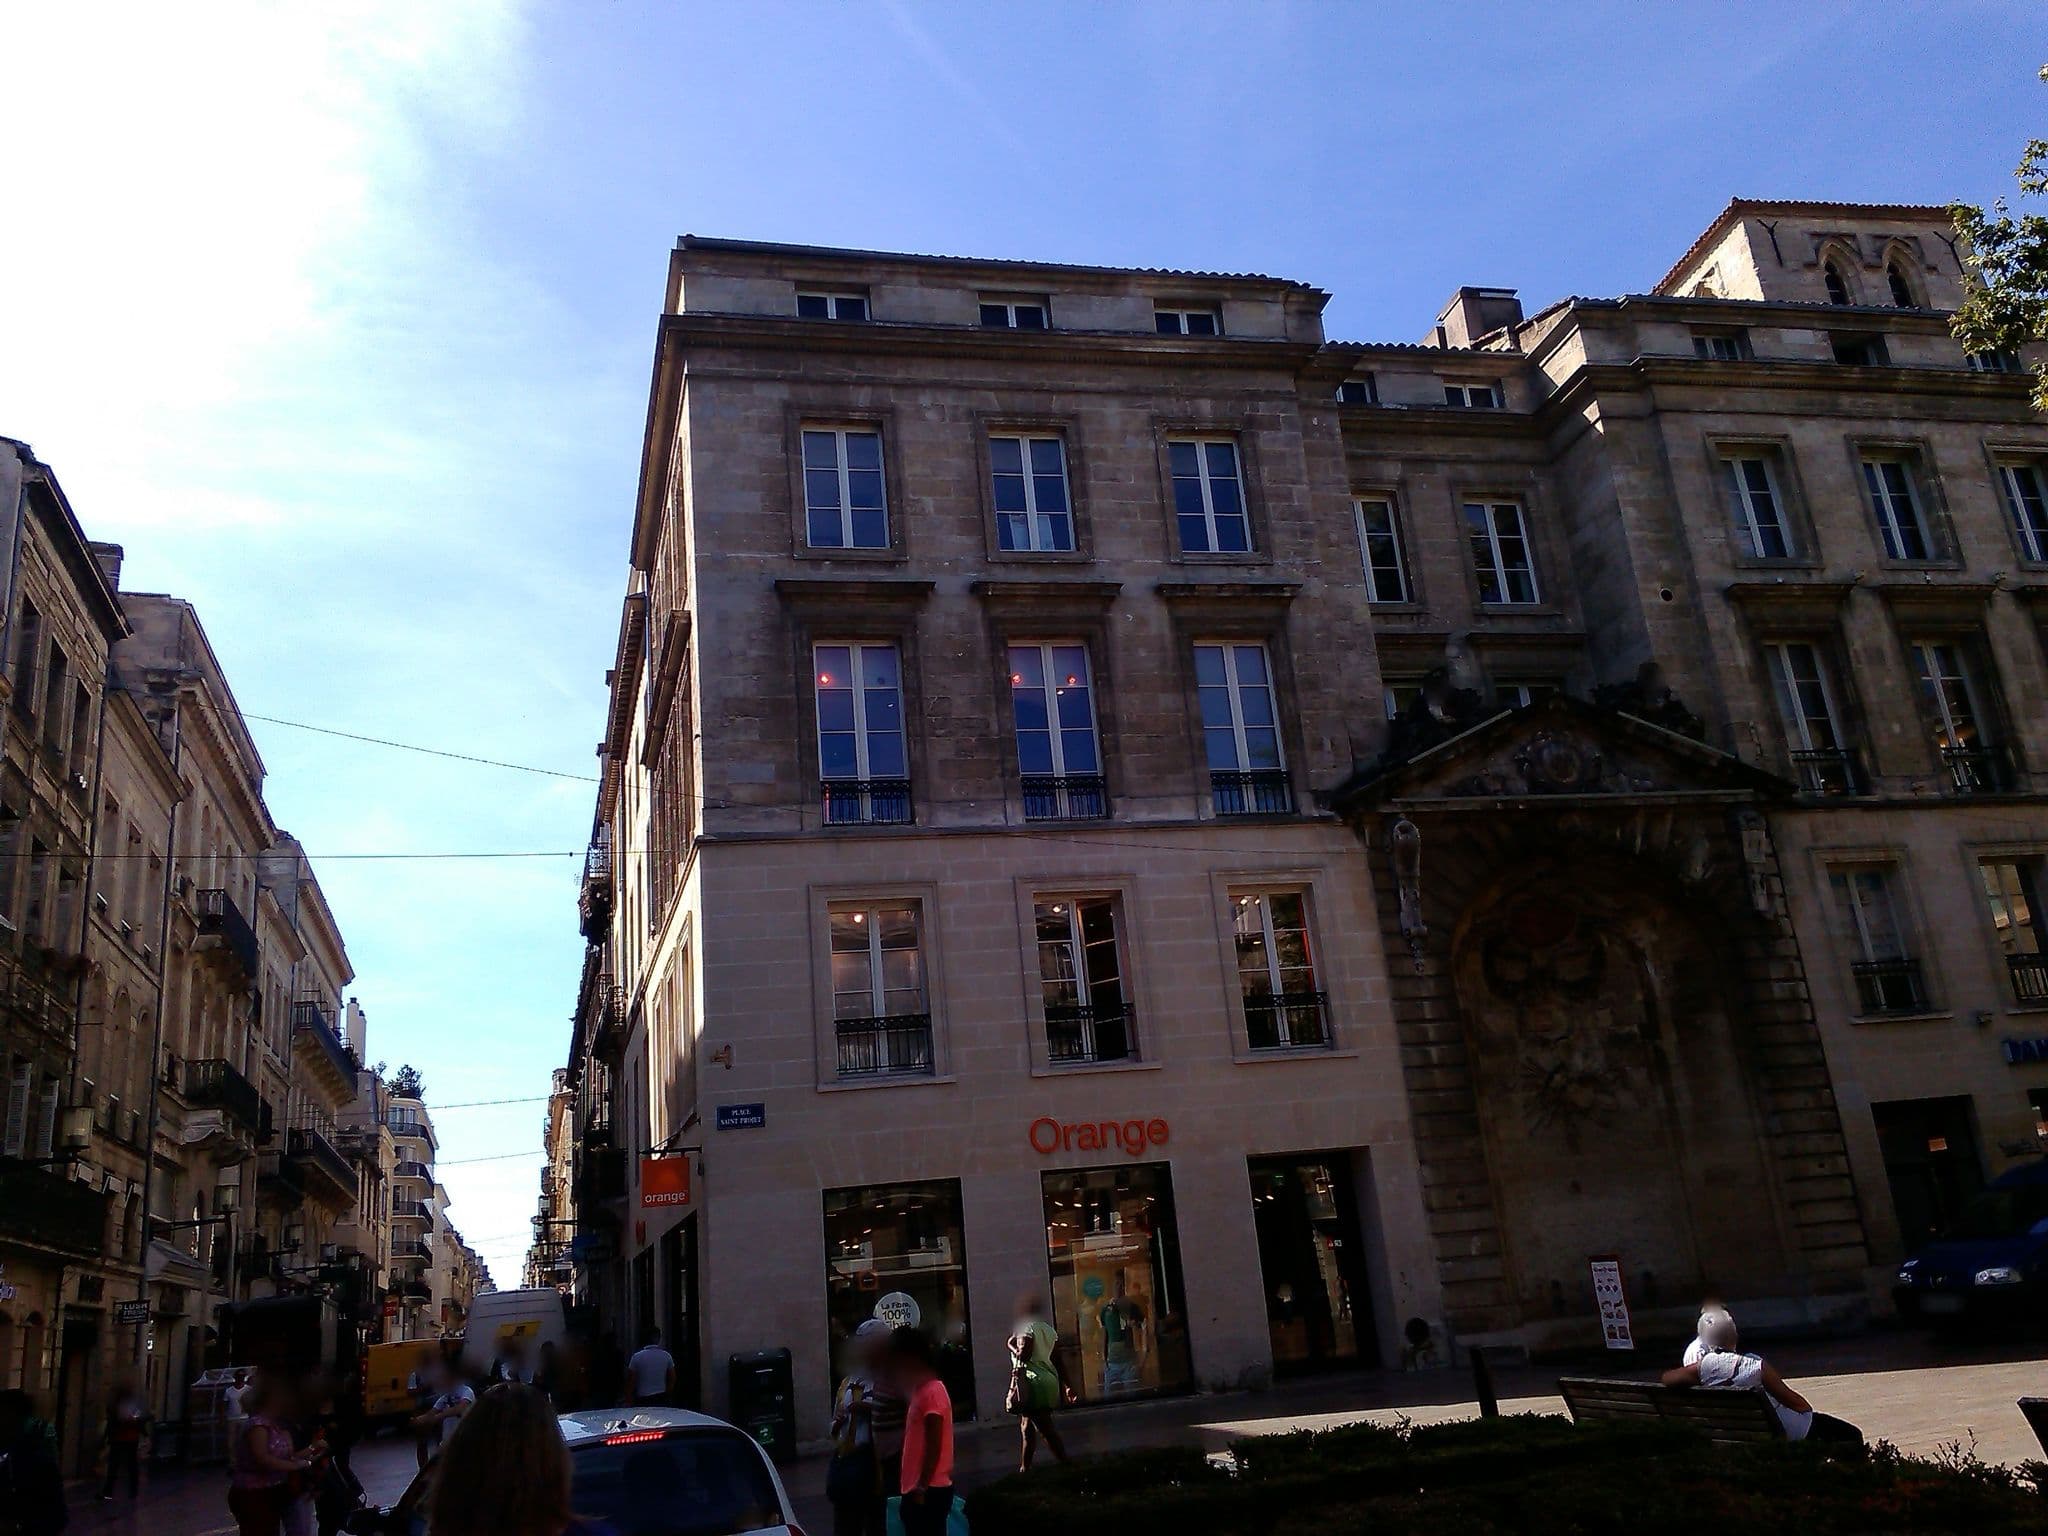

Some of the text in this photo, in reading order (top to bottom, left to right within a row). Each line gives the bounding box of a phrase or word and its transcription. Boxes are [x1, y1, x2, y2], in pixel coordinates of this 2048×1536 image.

[731, 1108, 751, 1116] PLACE
[1030, 1117, 1169, 1156] Orange
[644, 1191, 686, 1203] orange
[882, 1308, 911, 1320] 100%
